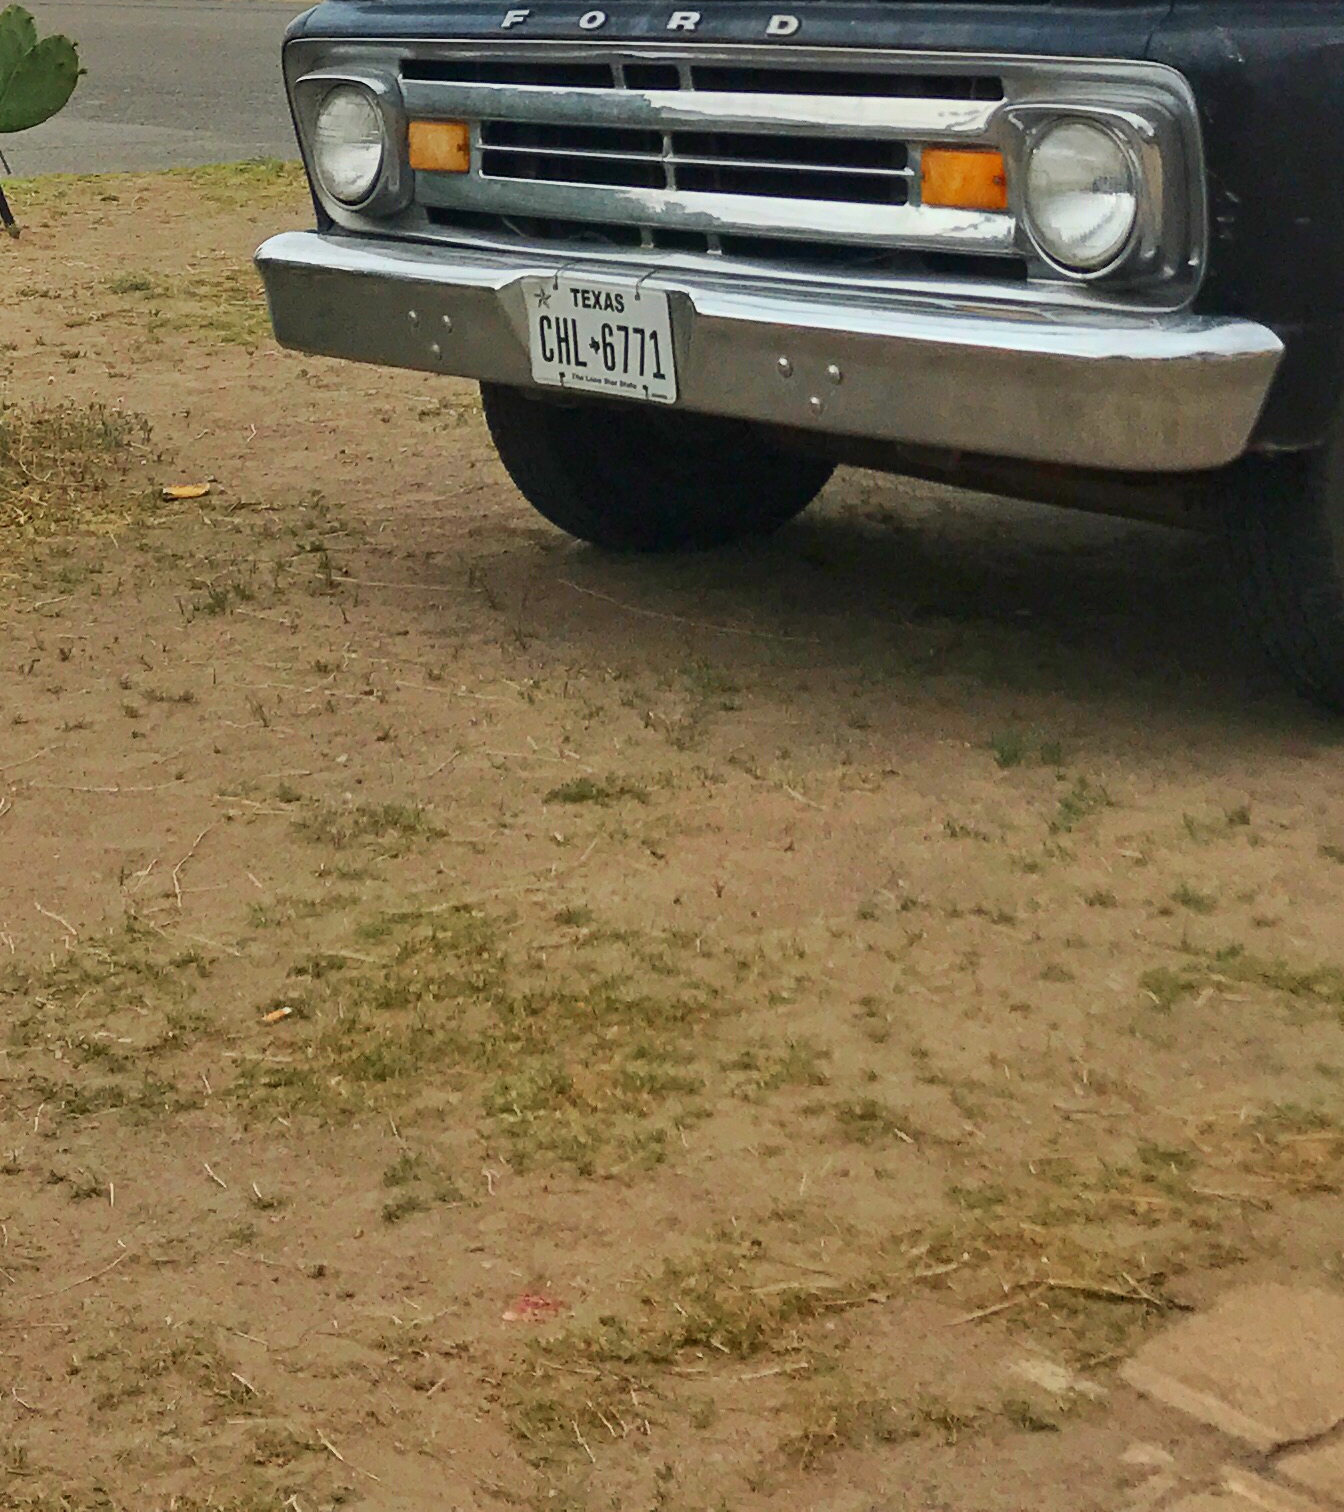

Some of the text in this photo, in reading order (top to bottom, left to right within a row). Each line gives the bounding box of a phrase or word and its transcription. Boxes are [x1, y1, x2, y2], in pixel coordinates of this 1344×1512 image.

[500, 9, 801, 37] FORD
[569, 287, 626, 314] TEXAS
[539, 314, 667, 381] CHL 6771
